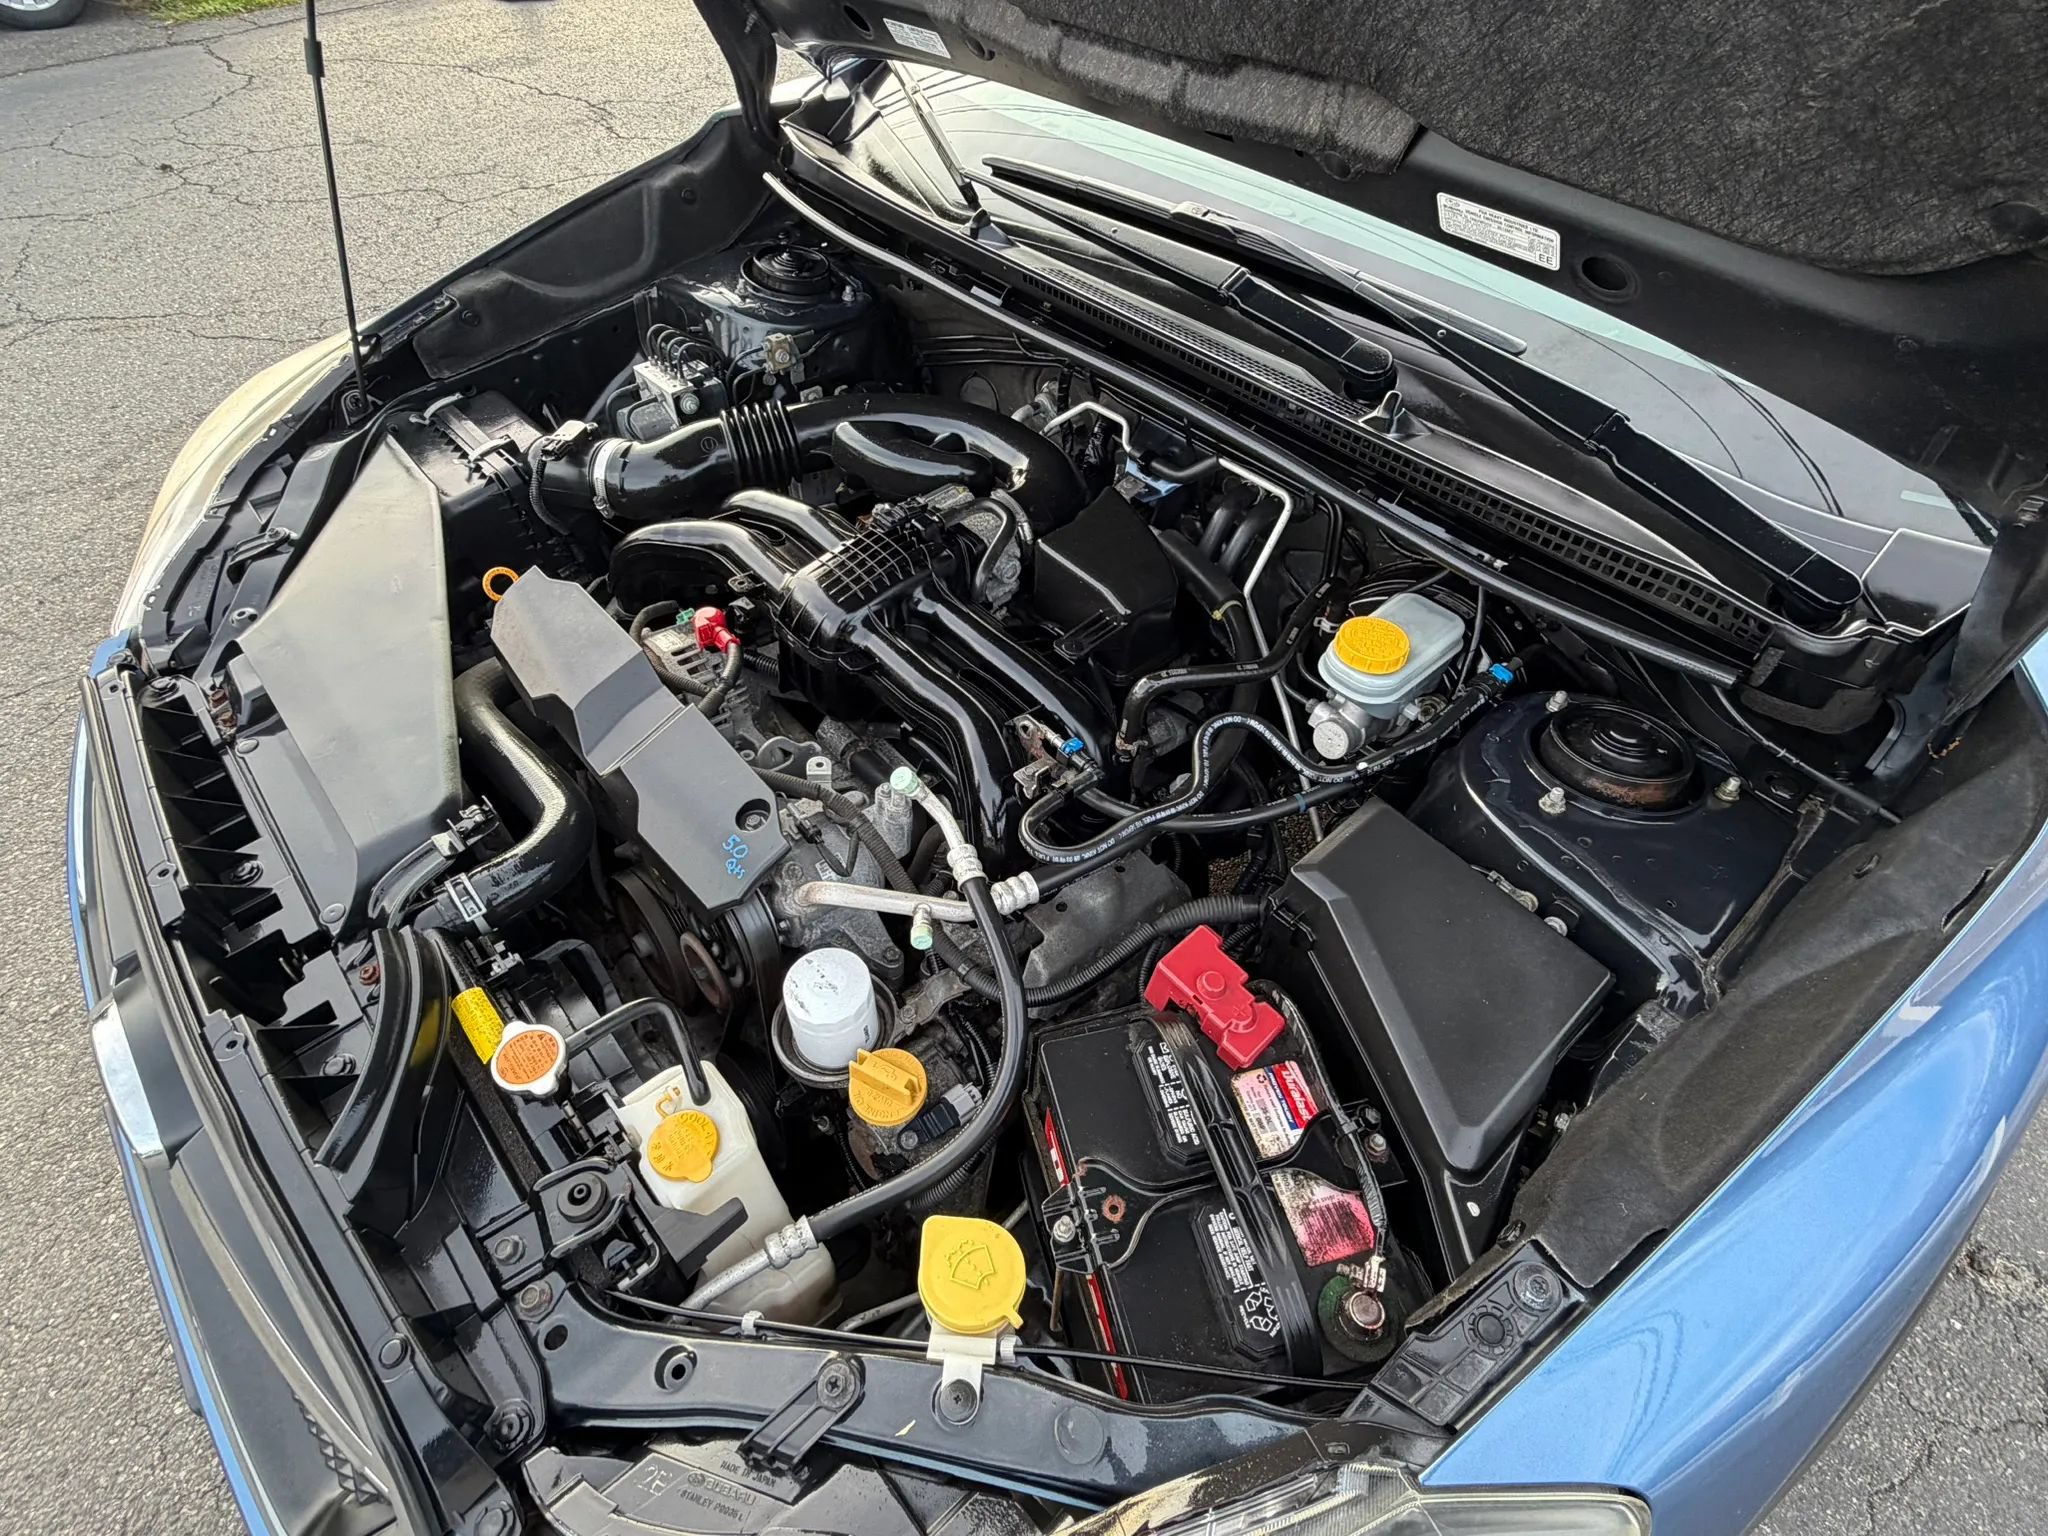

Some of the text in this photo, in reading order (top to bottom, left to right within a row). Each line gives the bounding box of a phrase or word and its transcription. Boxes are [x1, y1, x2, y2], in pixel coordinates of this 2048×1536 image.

[1538, 253, 1553, 265] EE
[722, 834, 748, 858] 5.0
[1097, 843, 1107, 853] NOT
[1106, 838, 1115, 846] DO
[1175, 1090, 1182, 1099] NO
[1281, 1070, 1313, 1120] Duralast
[720, 1461, 776, 1487] MADE IN JAPAN
[681, 1490, 713, 1507] STANLEY
[703, 1477, 757, 1506] SUBARU
